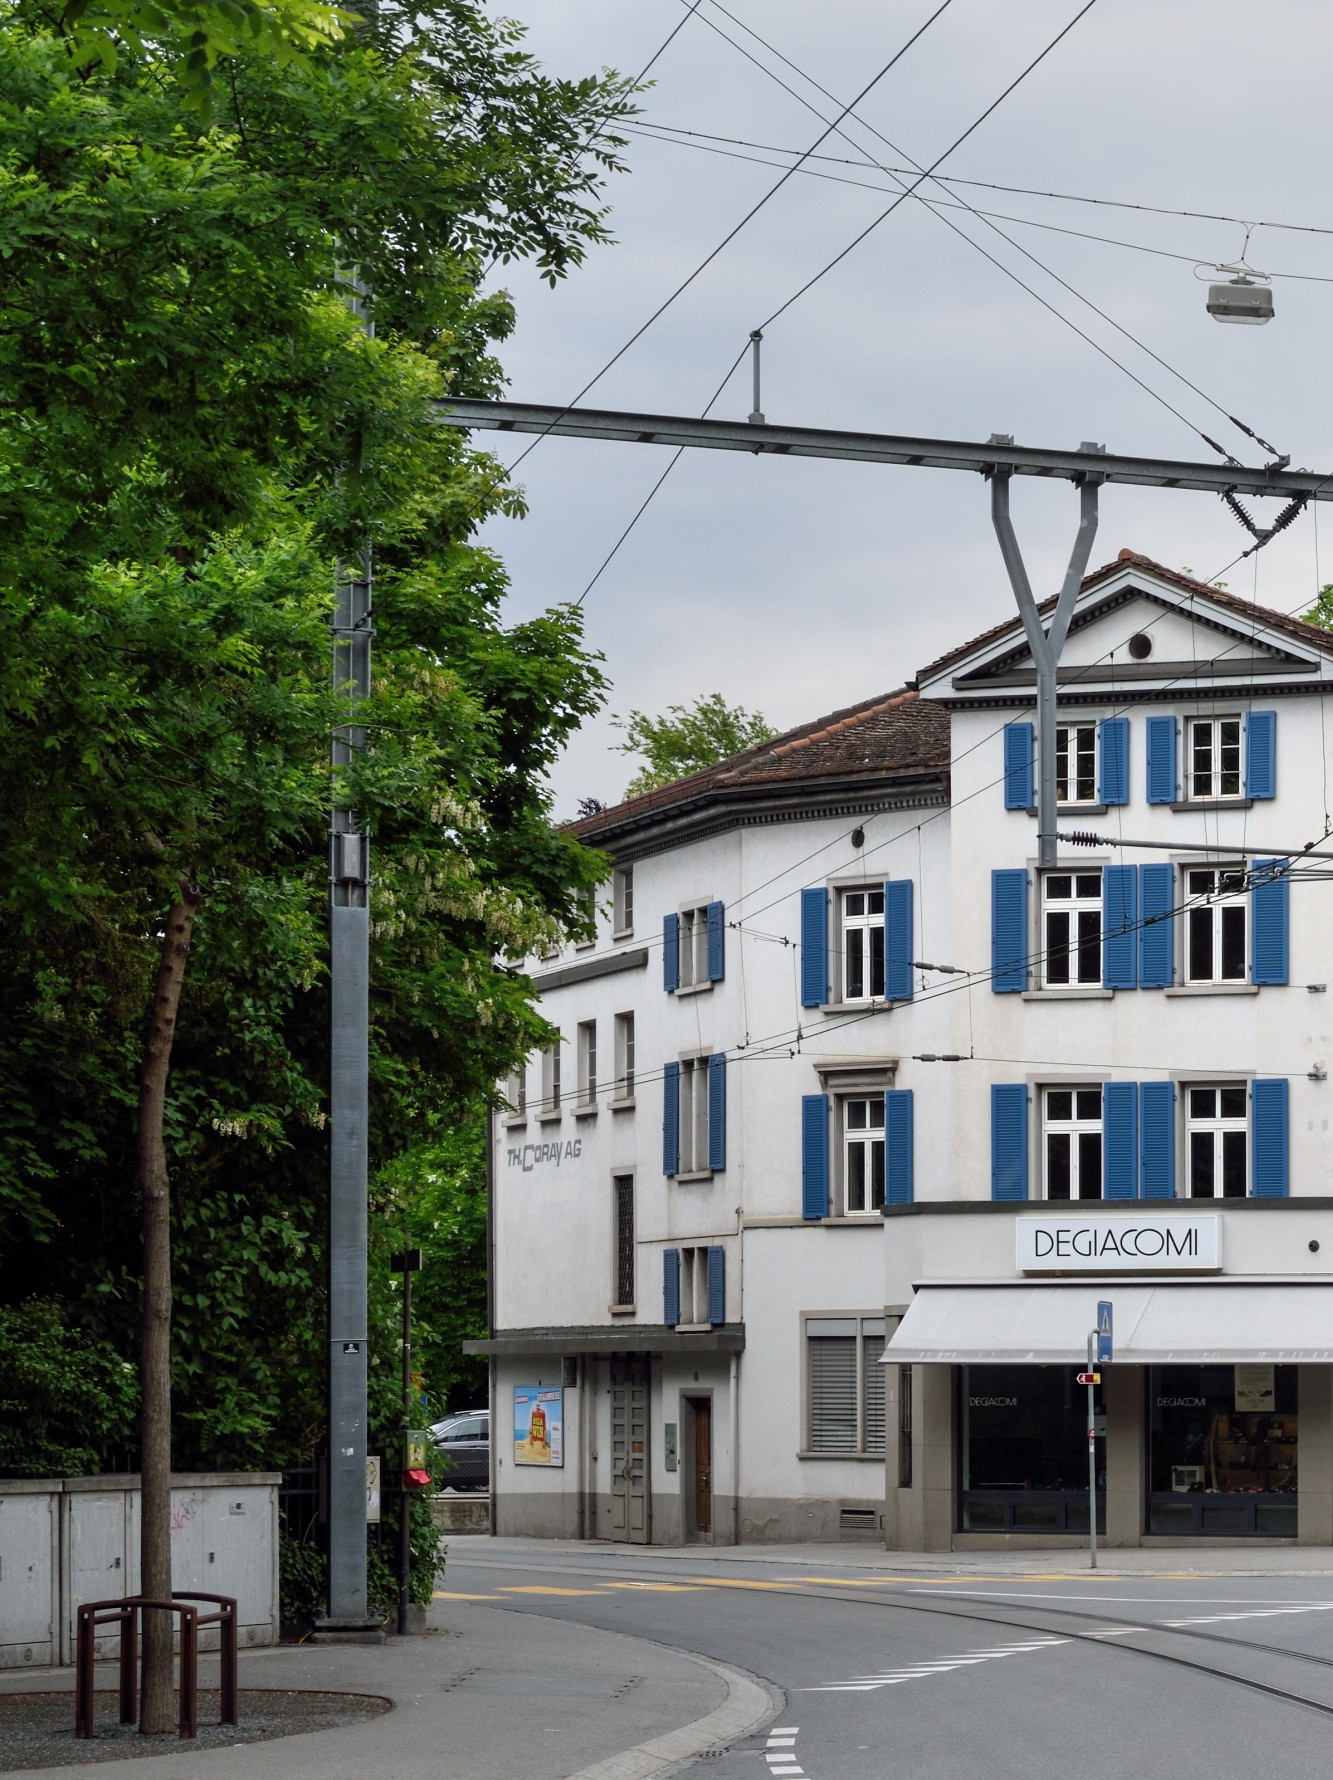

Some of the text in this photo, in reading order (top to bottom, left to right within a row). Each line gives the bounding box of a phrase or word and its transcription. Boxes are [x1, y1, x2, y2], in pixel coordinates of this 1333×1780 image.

[564, 1139, 582, 1159] AG
[1035, 1227, 1198, 1257] DEGIACOMI
[969, 1396, 1017, 1406] DEGIACOMI
[1157, 1397, 1206, 1407] DEGIACOMI
